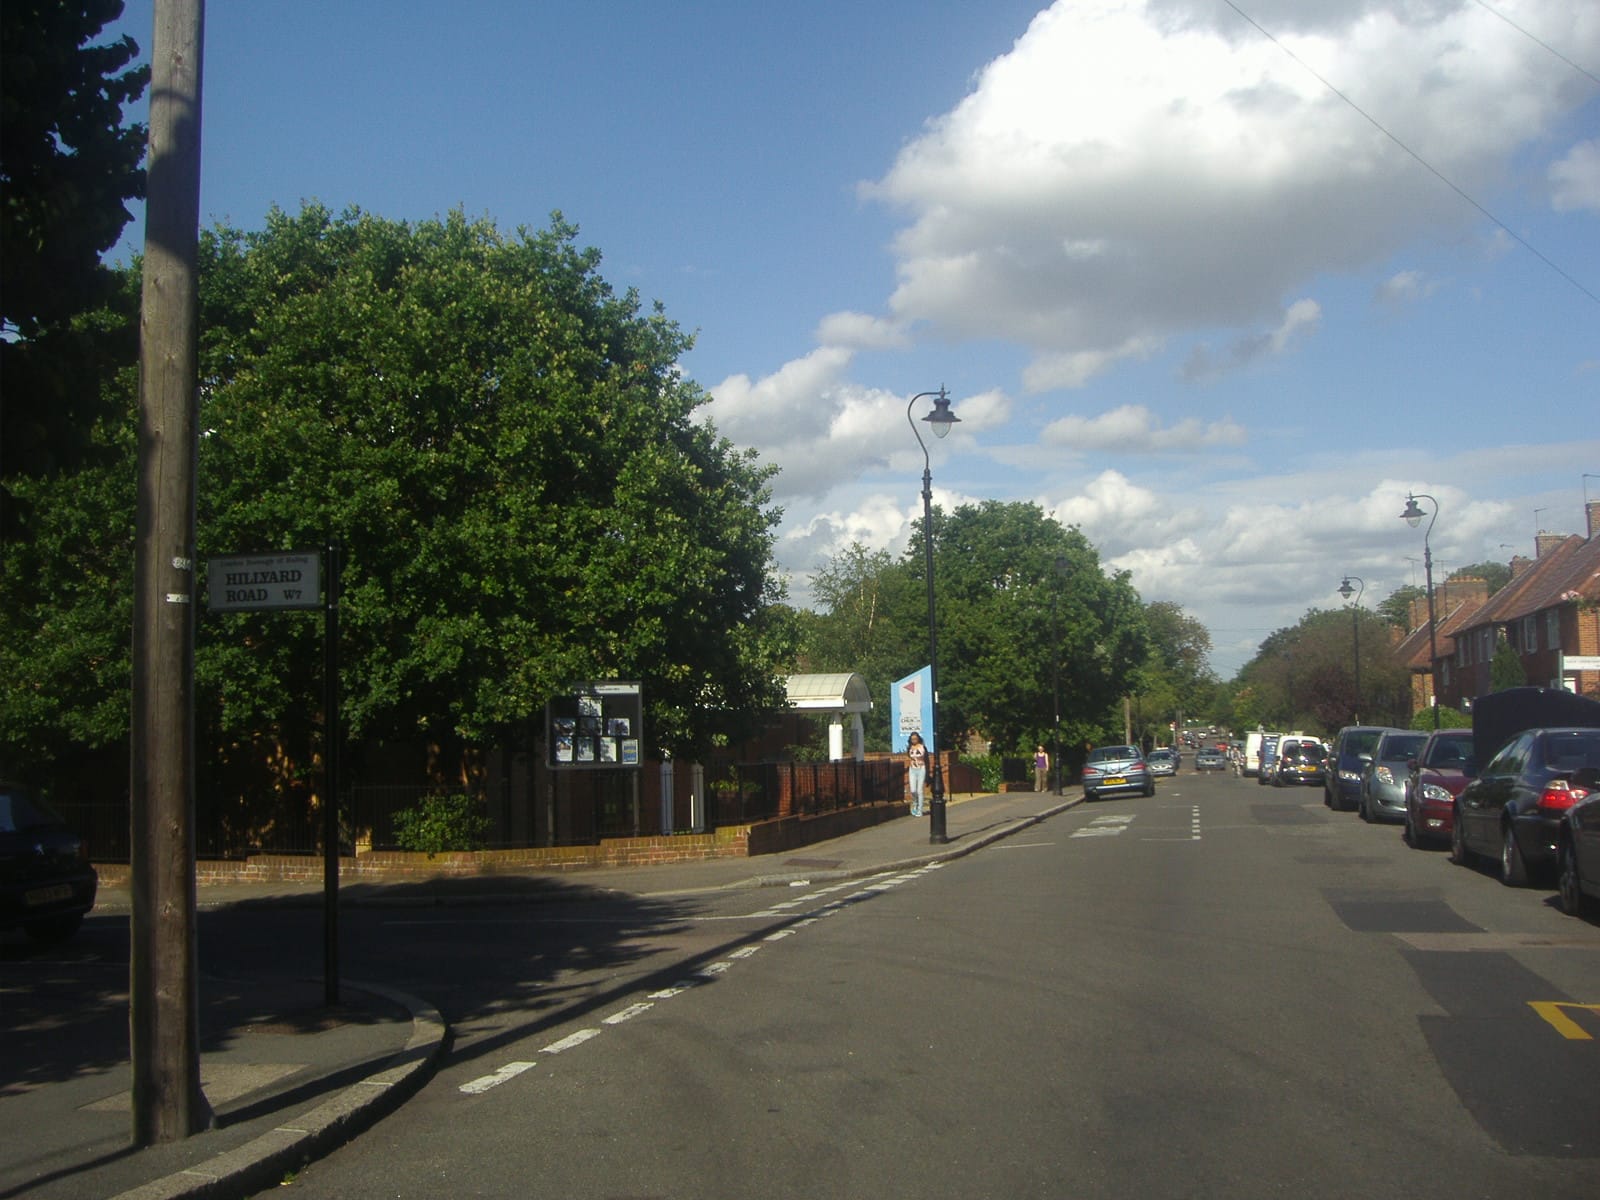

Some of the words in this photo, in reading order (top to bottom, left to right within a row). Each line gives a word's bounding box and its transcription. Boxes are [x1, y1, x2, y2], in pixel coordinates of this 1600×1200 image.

[225, 570, 302, 585] HILLYARD
[225, 587, 268, 602] ROAD
[283, 590, 302, 600] W7
